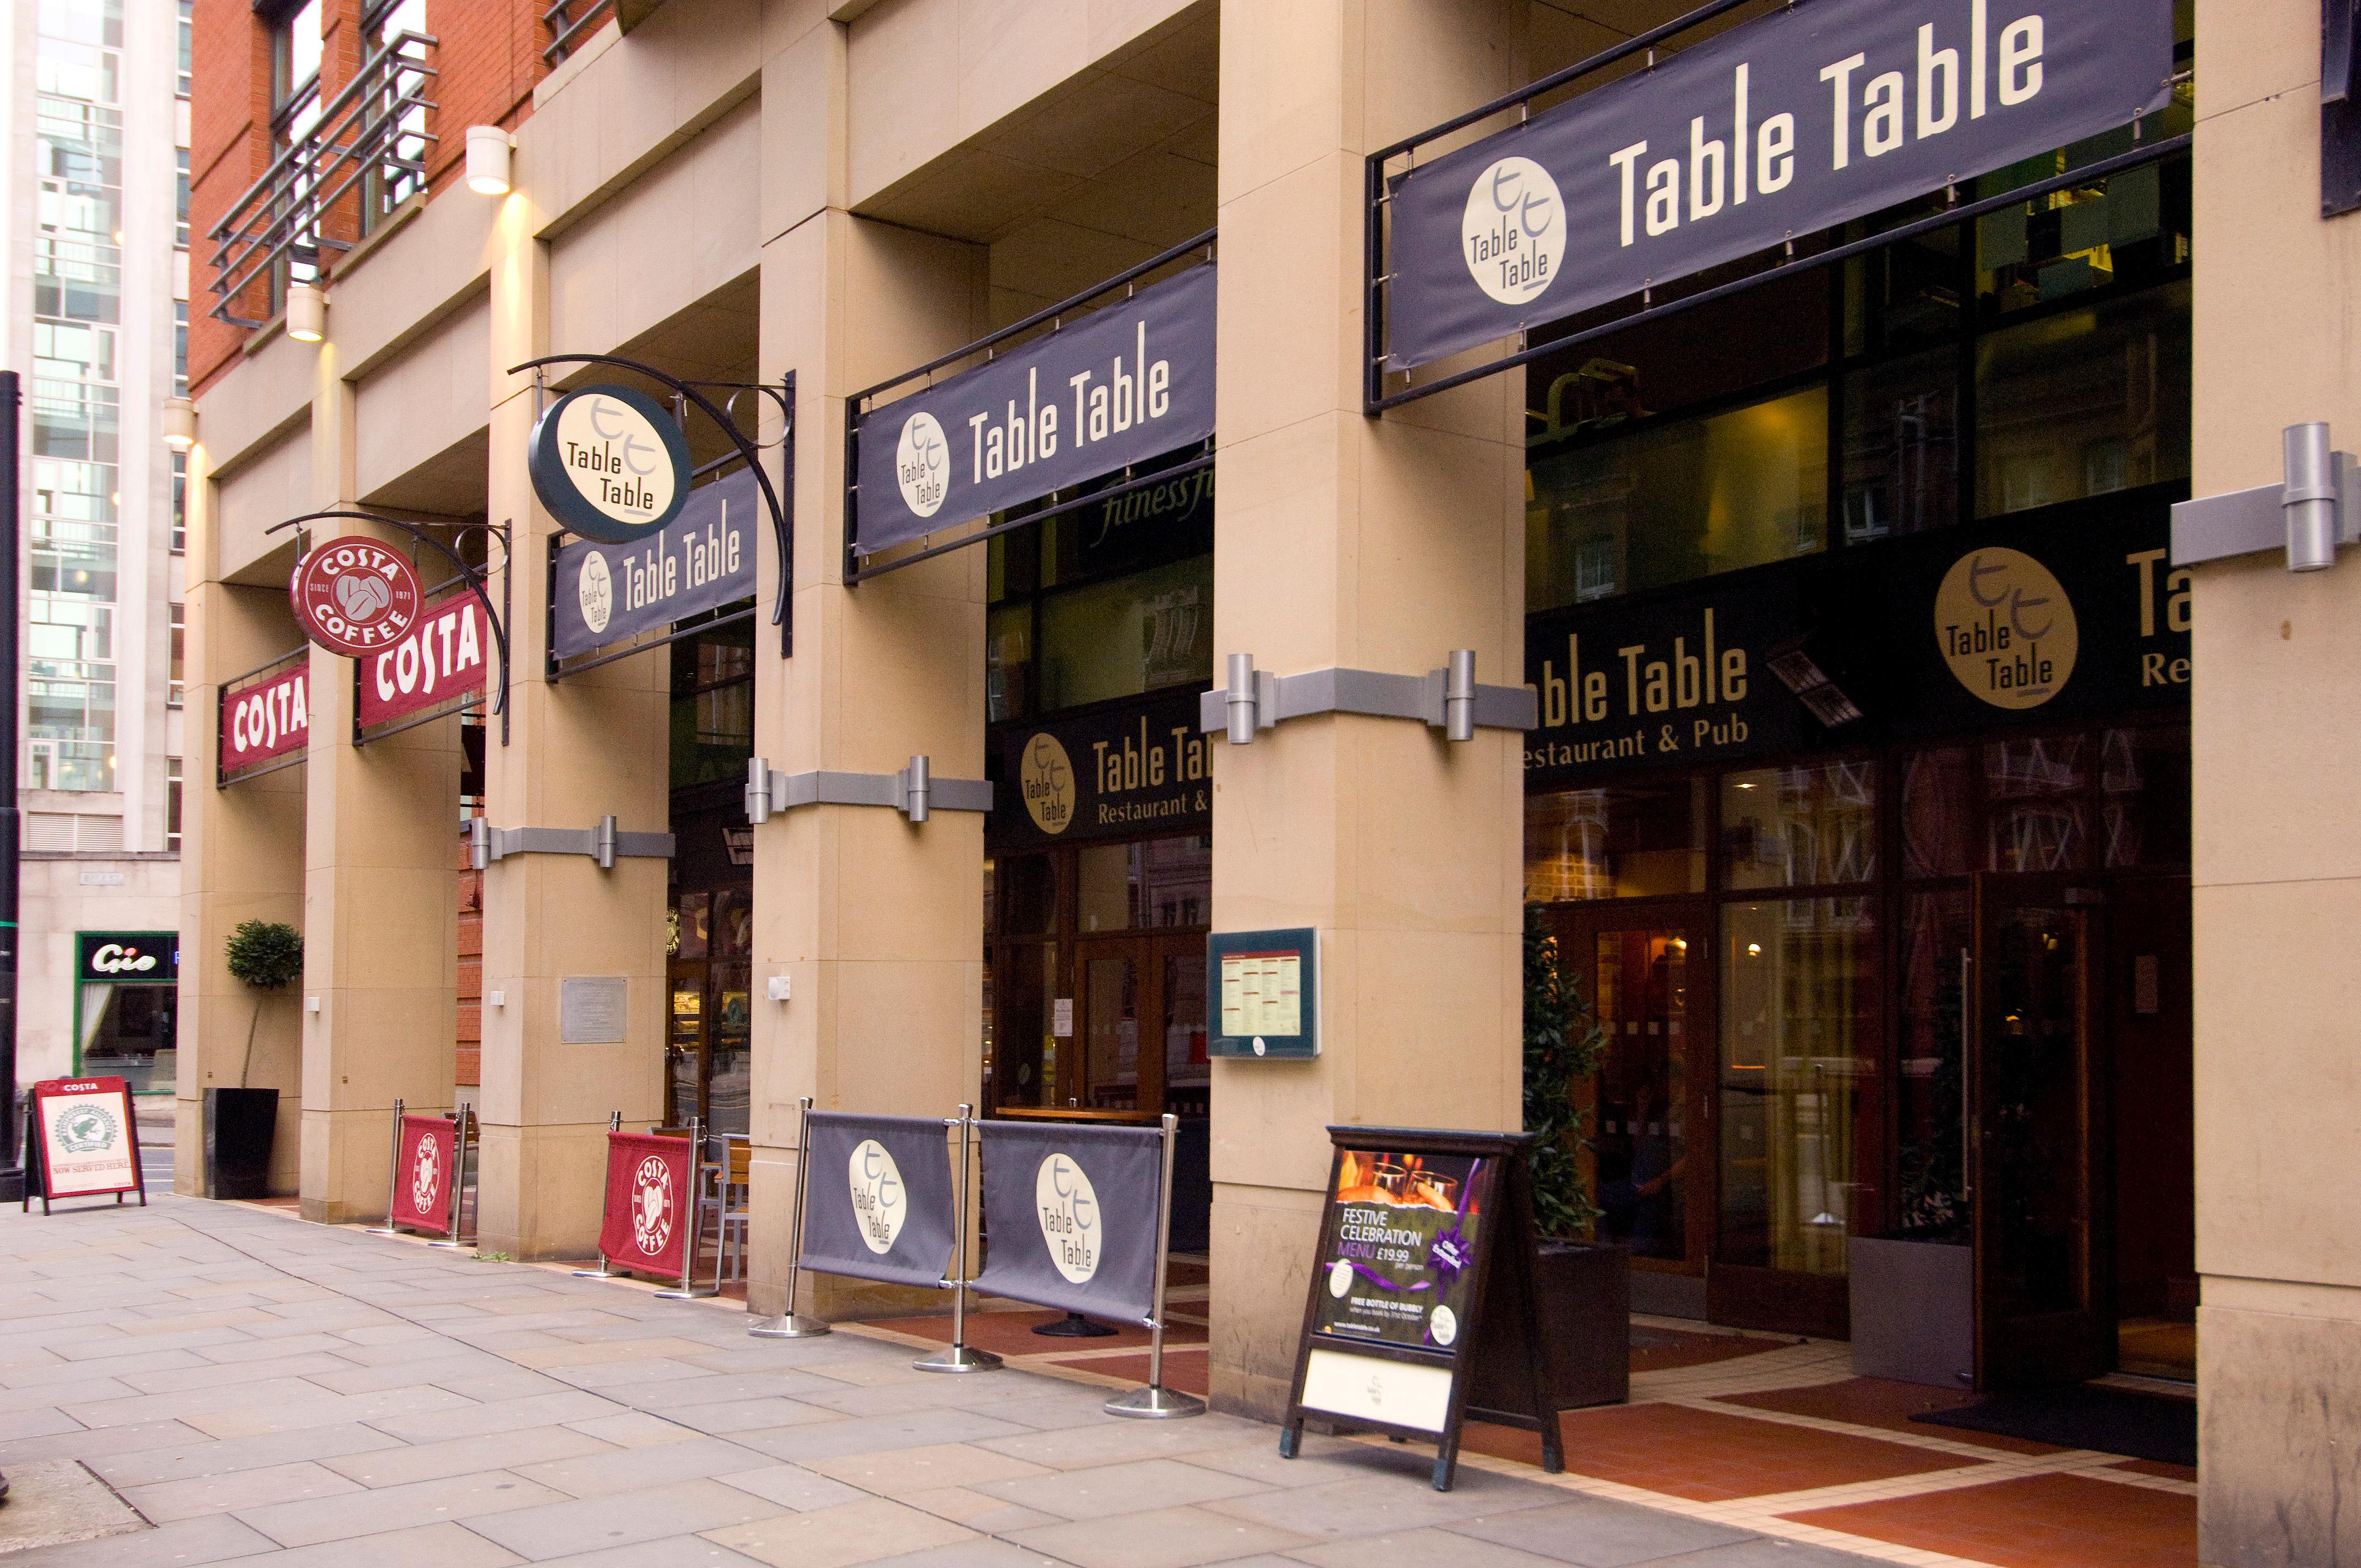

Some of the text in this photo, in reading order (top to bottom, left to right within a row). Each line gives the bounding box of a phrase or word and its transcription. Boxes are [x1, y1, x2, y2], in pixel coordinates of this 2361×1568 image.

[1609, 0, 2043, 248] Table Table
[1471, 215, 1517, 264] Table
[1500, 239, 1547, 289] Table
[969, 320, 1169, 484] Table Table
[567, 441, 621, 474] Table
[901, 452, 925, 484] Table
[600, 477, 653, 509] Table
[916, 472, 940, 505] Table
[322, 549, 399, 581] COSTA
[623, 499, 739, 611] Table Table
[310, 583, 329, 593] SINCE
[395, 591, 411, 600] 1971
[581, 582, 597, 606] Table
[315, 604, 408, 644] COFFEE
[591, 599, 606, 623] Table
[1946, 609, 2010, 657] Table
[376, 603, 480, 701] COSTA
[1618, 608, 1747, 715] Table
[1986, 642, 2052, 690] Table
[234, 676, 307, 753] COSTA
[1658, 724, 1679, 753] &
[1694, 713, 1749, 748] Pub
[1093, 716, 1164, 794] Table
[1026, 771, 1049, 799] Table
[1041, 793, 1066, 821] Table
[1099, 790, 1207, 824] Restaurant &
[92, 944, 156, 973] Gio
[64, 1083, 98, 1091] COSTA
[418, 1136, 436, 1160] COSTA
[72, 1163, 105, 1173] SERVED
[638, 1159, 668, 1190] COSTA
[853, 1182, 875, 1211] Table
[636, 1214, 669, 1251] COFFEE
[868, 1210, 890, 1239] Table
[1043, 1201, 1072, 1234] Table
[1342, 1208, 1388, 1227] FESTIVE
[1061, 1233, 1091, 1267] Table
[1340, 1224, 1422, 1246] CELEBRATION
[1337, 1242, 1410, 1262] MENU £19.99
